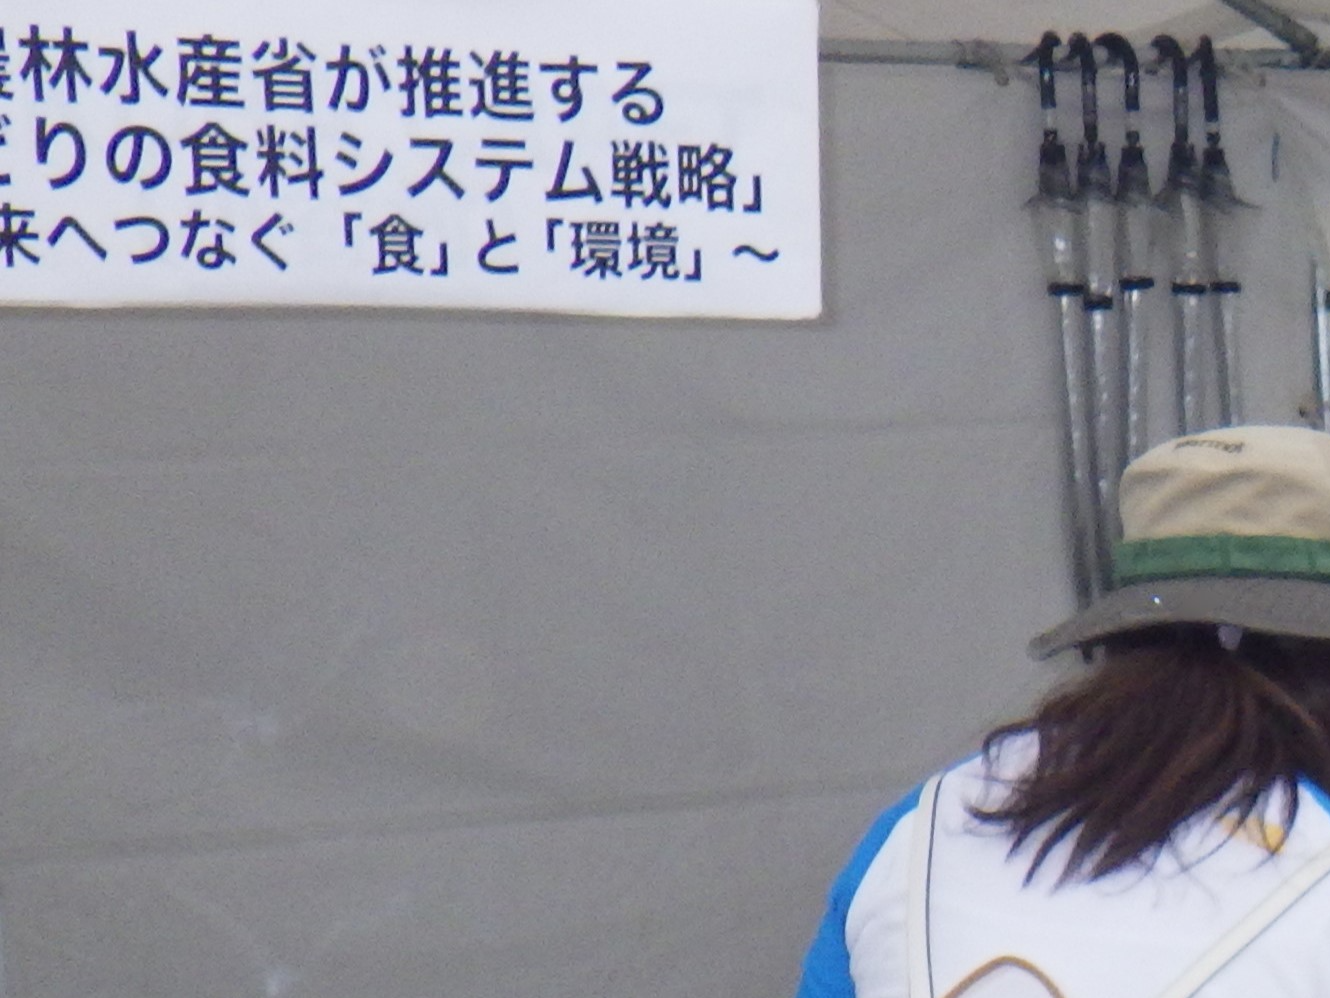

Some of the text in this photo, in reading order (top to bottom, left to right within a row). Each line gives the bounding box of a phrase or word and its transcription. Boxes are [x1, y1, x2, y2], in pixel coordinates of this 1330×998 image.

[0, 24, 665, 125] 林水産省が推進する
[0, 115, 762, 213] りの食料システム戦略」
